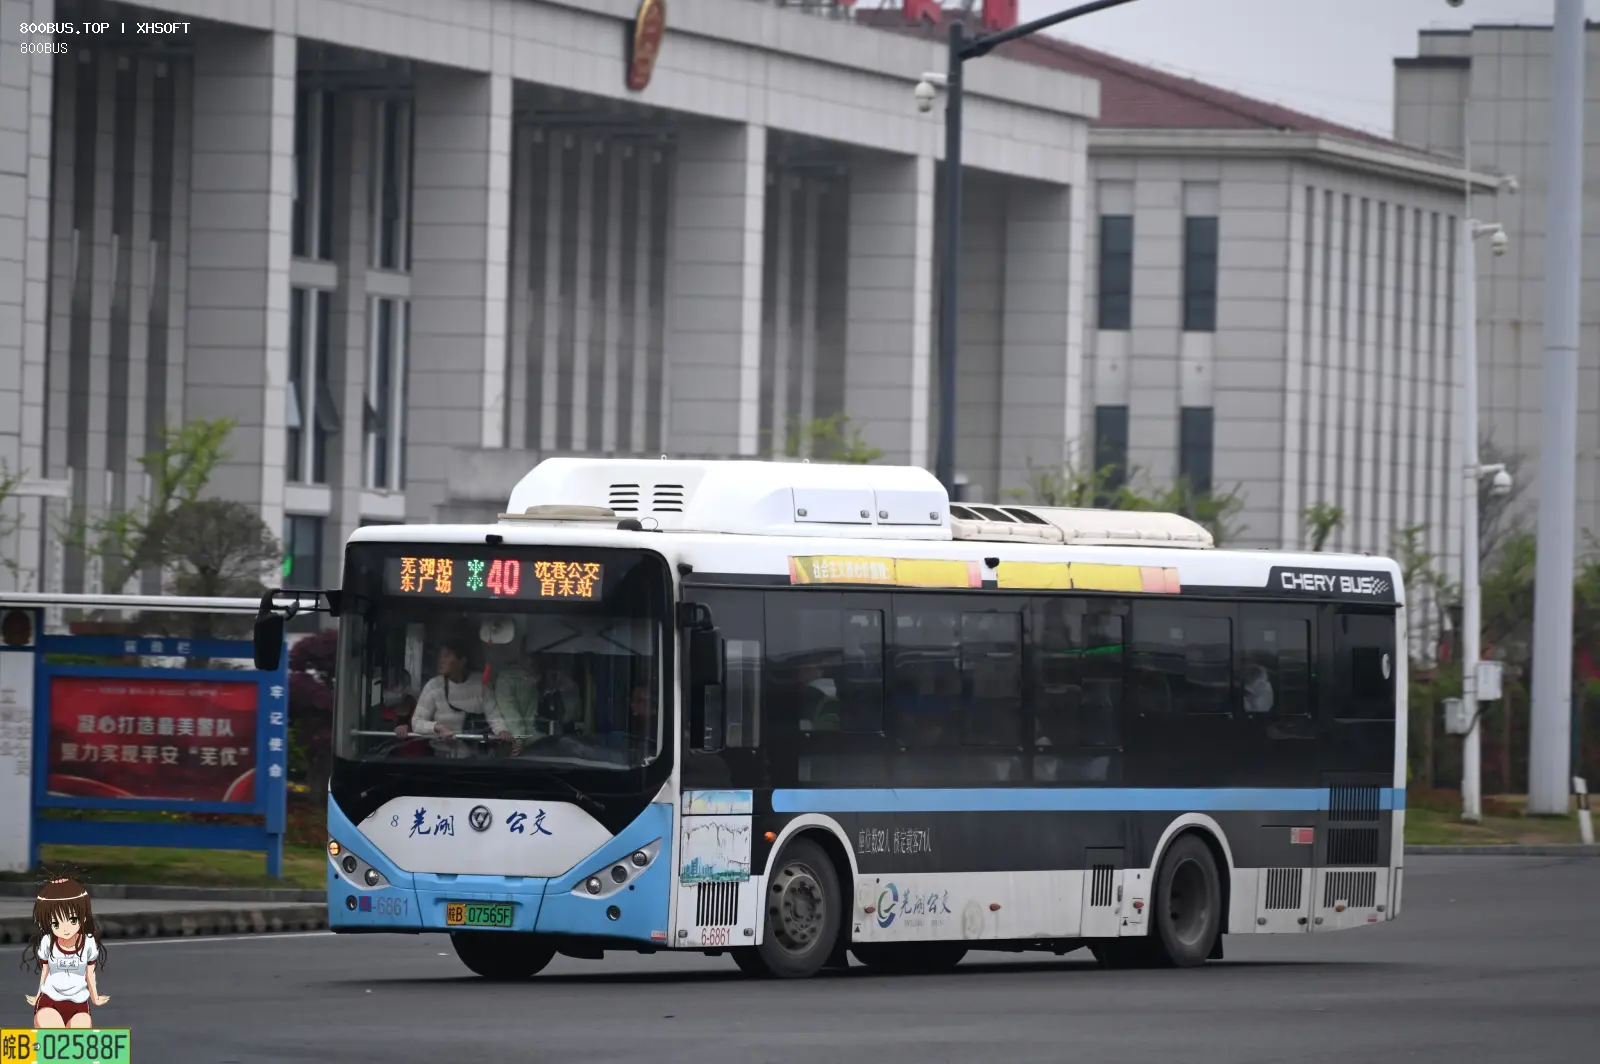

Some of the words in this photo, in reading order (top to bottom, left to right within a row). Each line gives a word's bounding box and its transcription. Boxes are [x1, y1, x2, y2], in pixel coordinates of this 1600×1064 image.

[401, 557, 453, 576] 芜湖站
[534, 560, 600, 581] 沈巷公交
[401, 575, 452, 594] 东广场
[487, 559, 520, 595] 40
[1280, 571, 1337, 592] CHERY
[1339, 575, 1374, 594] BUS
[540, 578, 593, 597] 首末站
[390, 814, 399, 828] 8
[505, 808, 553, 836] 公交
[701, 927, 731, 946] 6-6861
